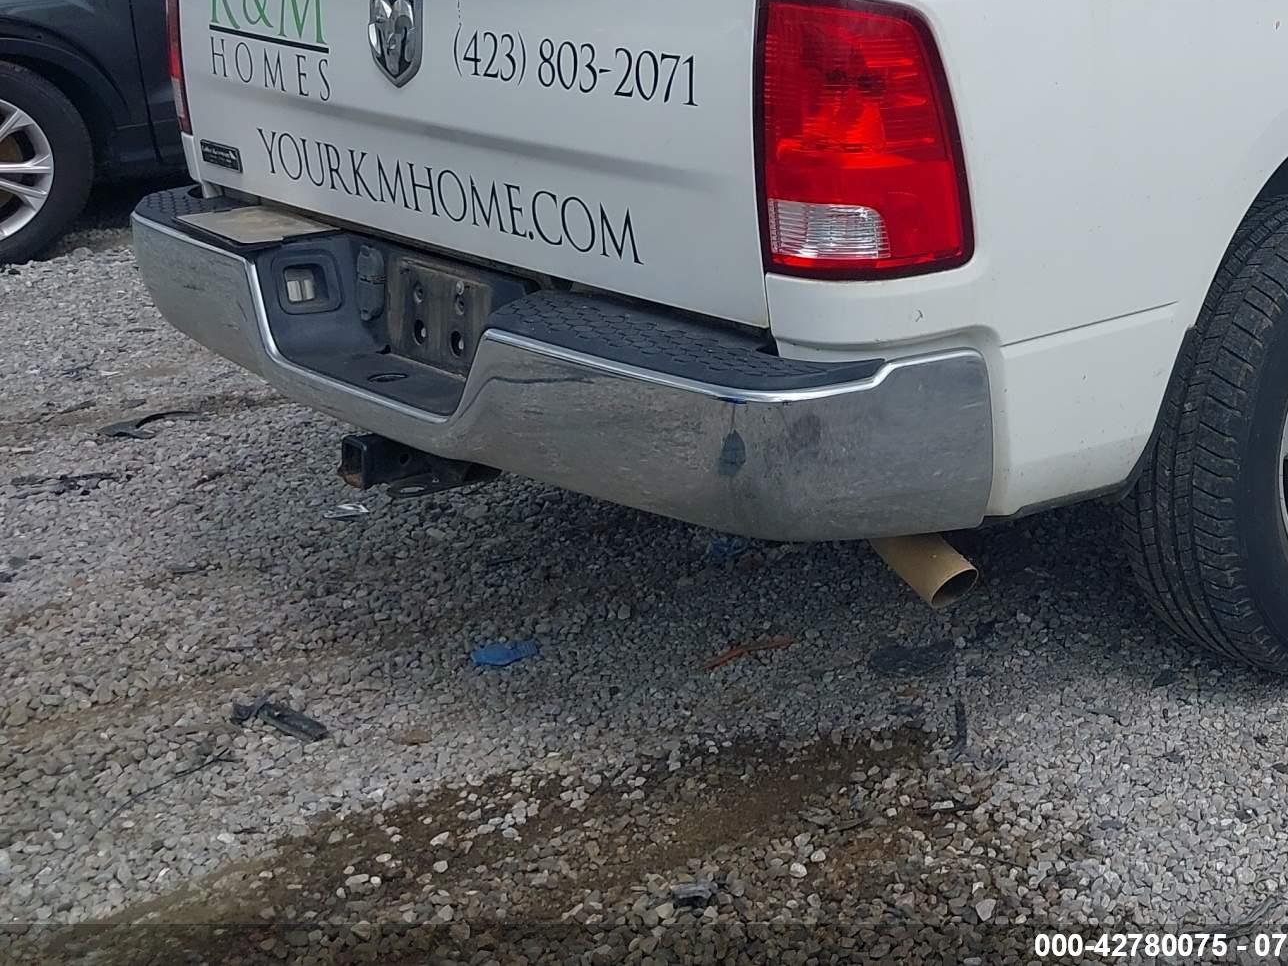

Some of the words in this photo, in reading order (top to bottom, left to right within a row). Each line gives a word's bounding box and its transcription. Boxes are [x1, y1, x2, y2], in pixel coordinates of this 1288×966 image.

[211, 36, 332, 103] HOMES
[454, 22, 527, 86] (423)
[538, 38, 699, 107] 803-2071
[256, 127, 645, 266] YOURKMHOME.COM
